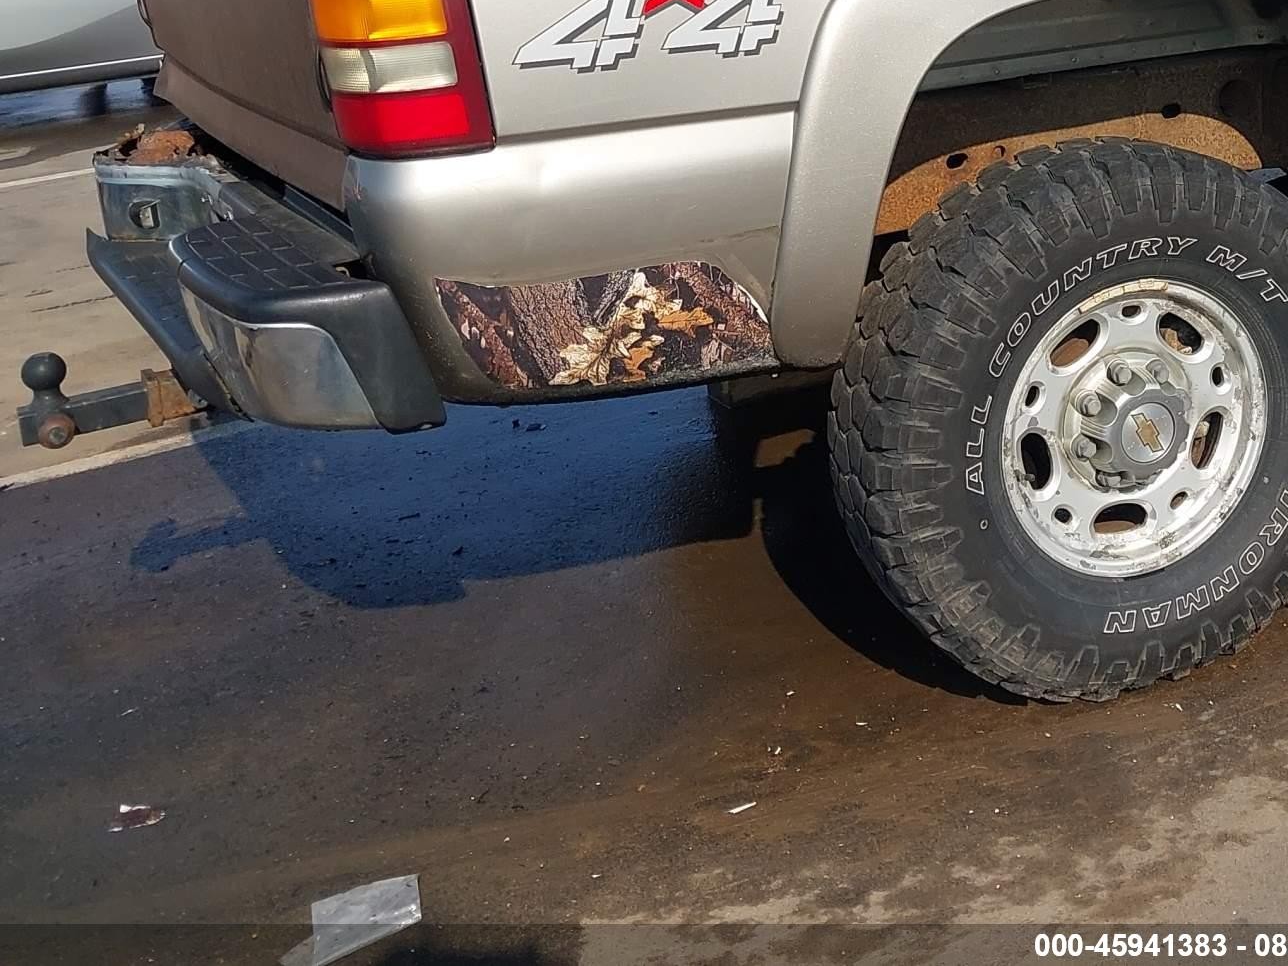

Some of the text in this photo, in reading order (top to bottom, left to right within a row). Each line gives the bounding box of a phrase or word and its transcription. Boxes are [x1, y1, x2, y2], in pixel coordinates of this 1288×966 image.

[965, 236, 1288, 496] ALL COUNTRY M/T
